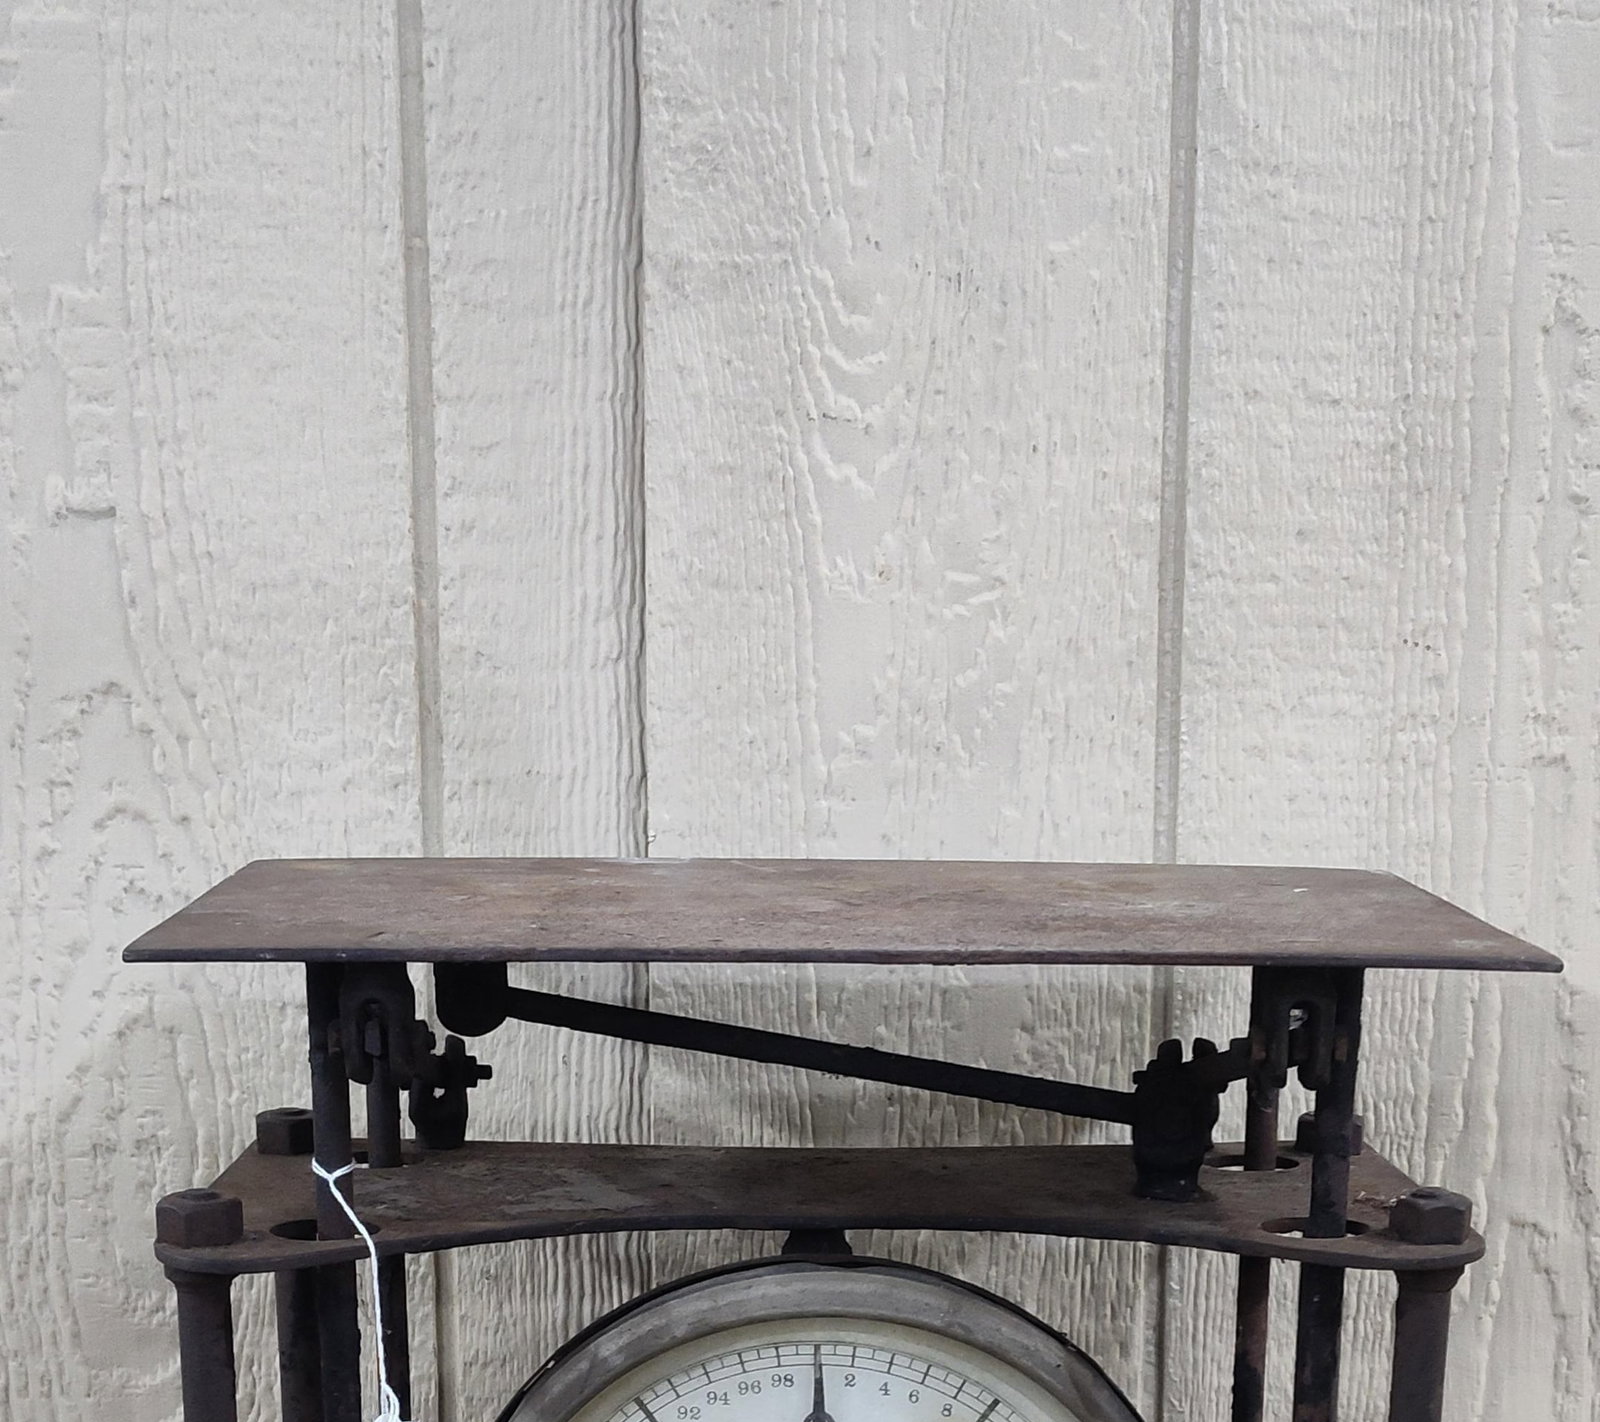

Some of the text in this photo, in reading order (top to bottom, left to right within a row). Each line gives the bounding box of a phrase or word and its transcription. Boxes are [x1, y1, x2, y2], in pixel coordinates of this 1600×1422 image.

[772, 1374, 794, 1387] 98
[845, 1374, 856, 1387] 2
[738, 1380, 761, 1395] 96
[879, 1382, 890, 1396] 4
[707, 1391, 730, 1405] 94
[909, 1390, 919, 1403] 6
[677, 1406, 701, 1420] 92
[941, 1404, 952, 1417] 8
